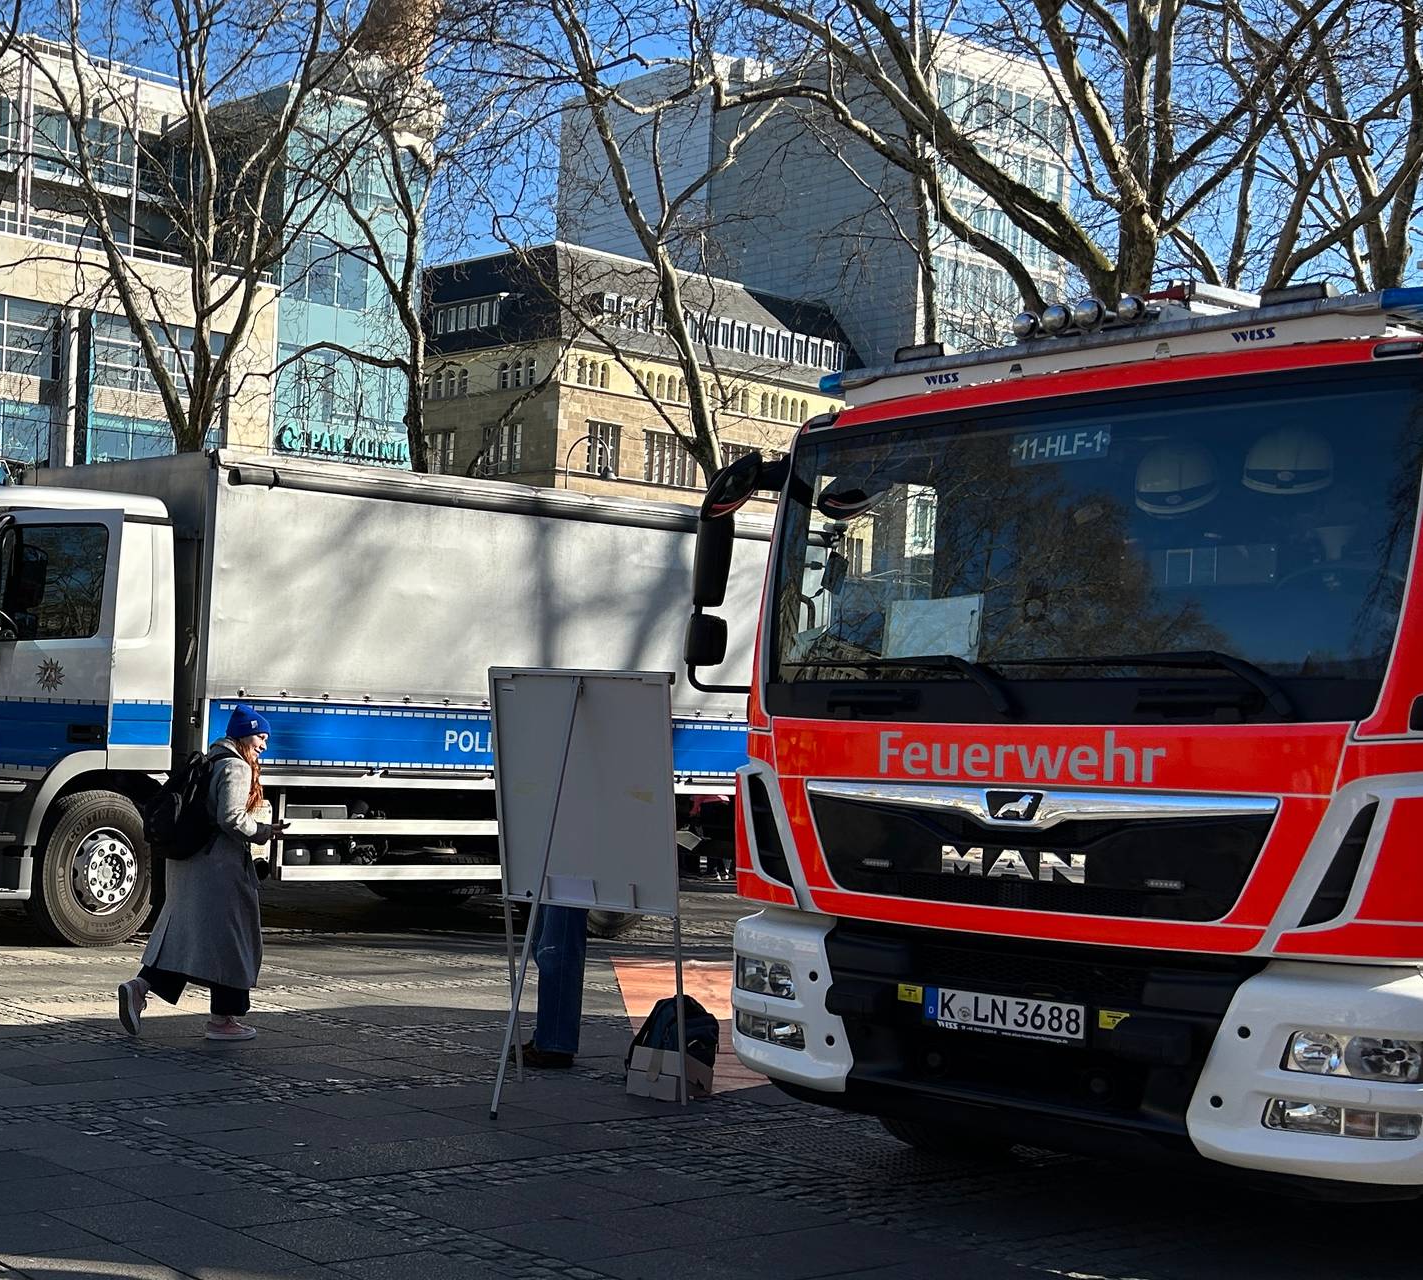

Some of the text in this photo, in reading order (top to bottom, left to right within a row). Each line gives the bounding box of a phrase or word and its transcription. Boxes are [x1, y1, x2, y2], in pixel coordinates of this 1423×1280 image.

[1231, 327, 1276, 343] WISS
[924, 372, 960, 386] WISS
[1019, 430, 1104, 460] 11-HLF-1
[445, 730, 493, 753] POLI
[879, 730, 1166, 783] Feuerwehr
[941, 845, 1086, 884] MAN
[940, 992, 956, 1019] K
[973, 996, 1007, 1026] LN
[1013, 1001, 1080, 1035] 3688
